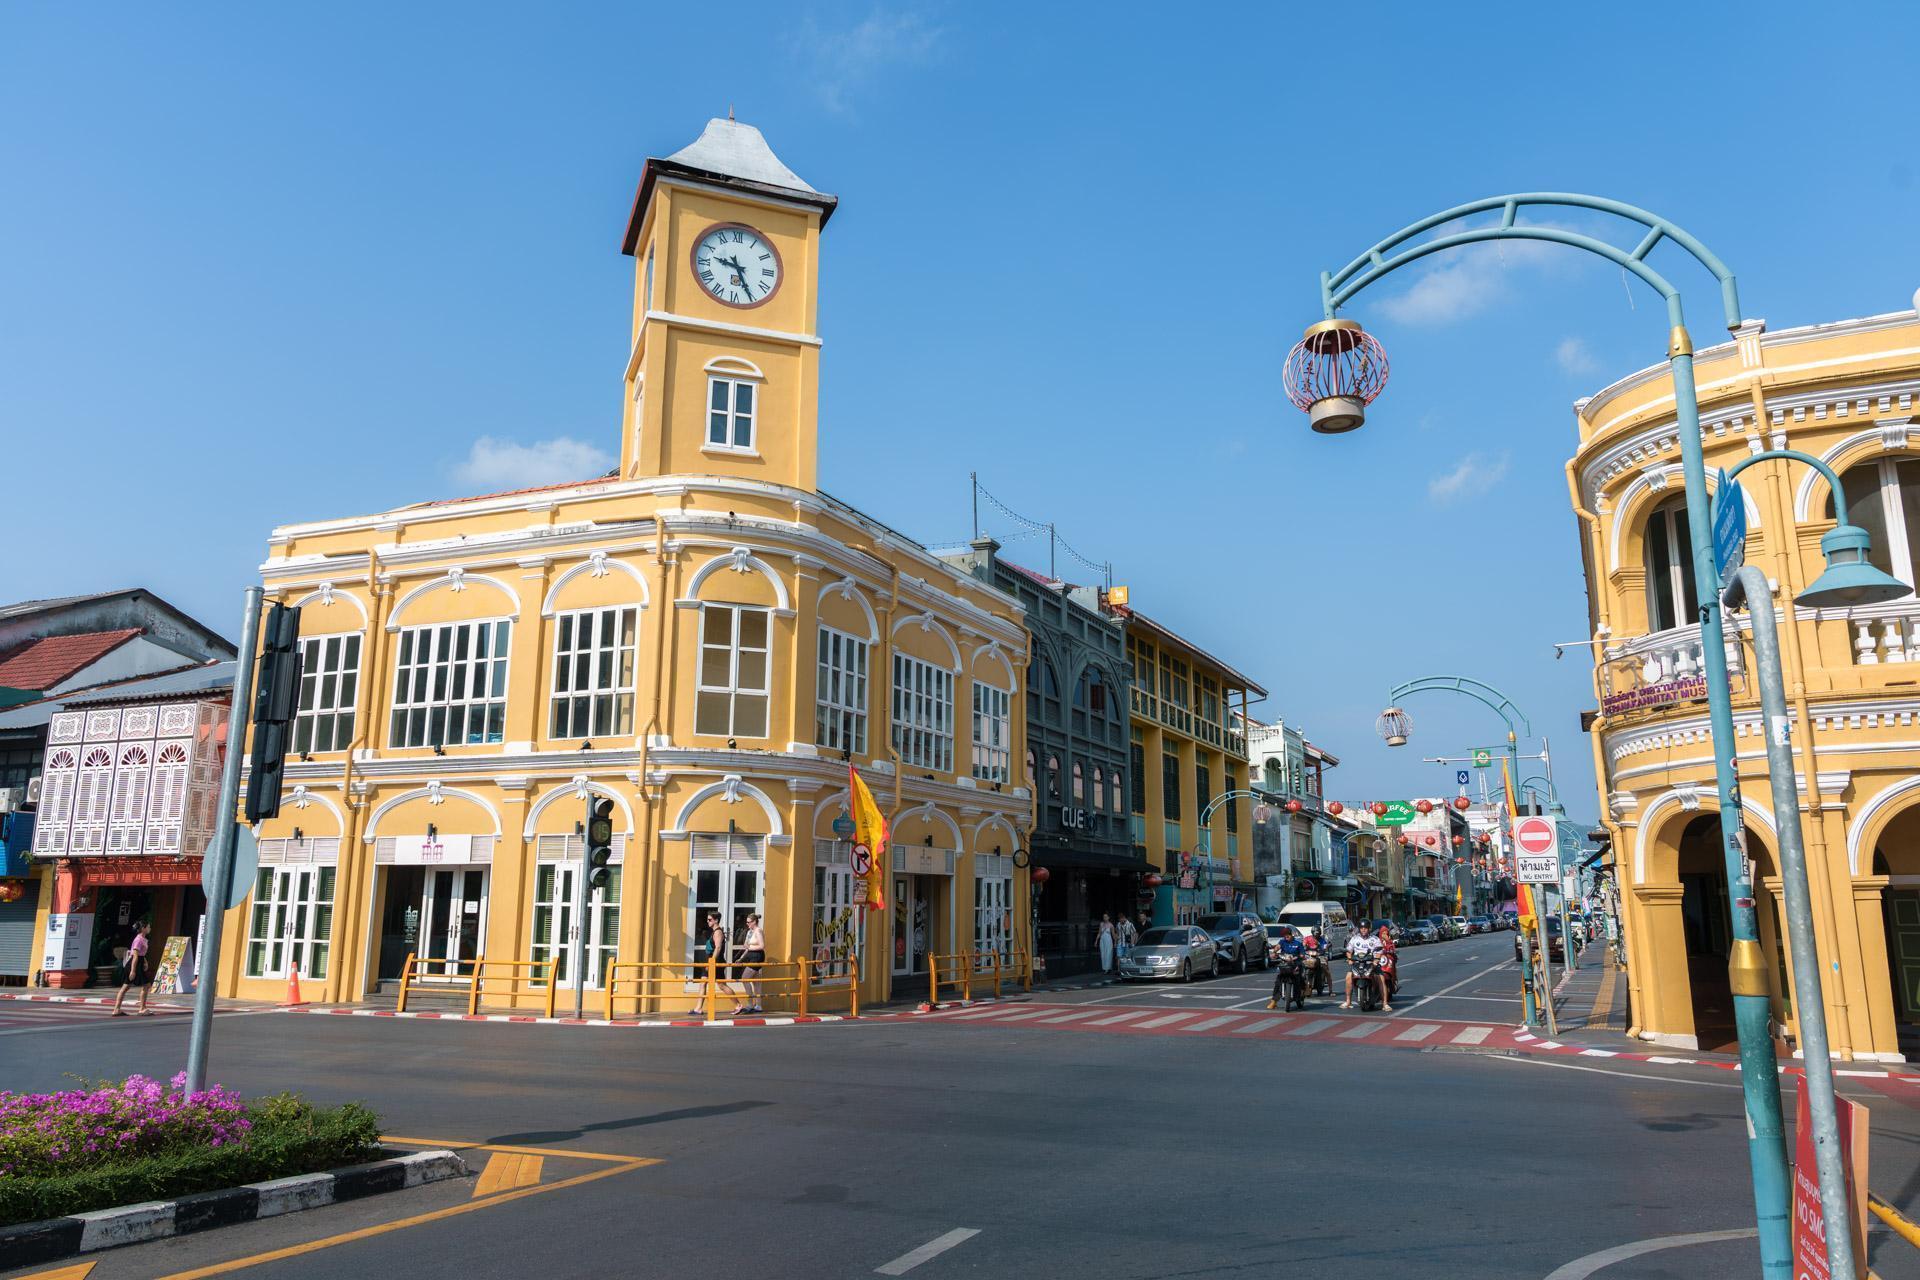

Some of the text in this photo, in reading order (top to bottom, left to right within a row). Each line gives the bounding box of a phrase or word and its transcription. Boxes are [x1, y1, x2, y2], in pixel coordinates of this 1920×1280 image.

[718, 232, 728, 244] XI
[732, 232, 743, 243] XII
[762, 269, 774, 277] III
[1797, 1197, 1826, 1243] NO SMO
